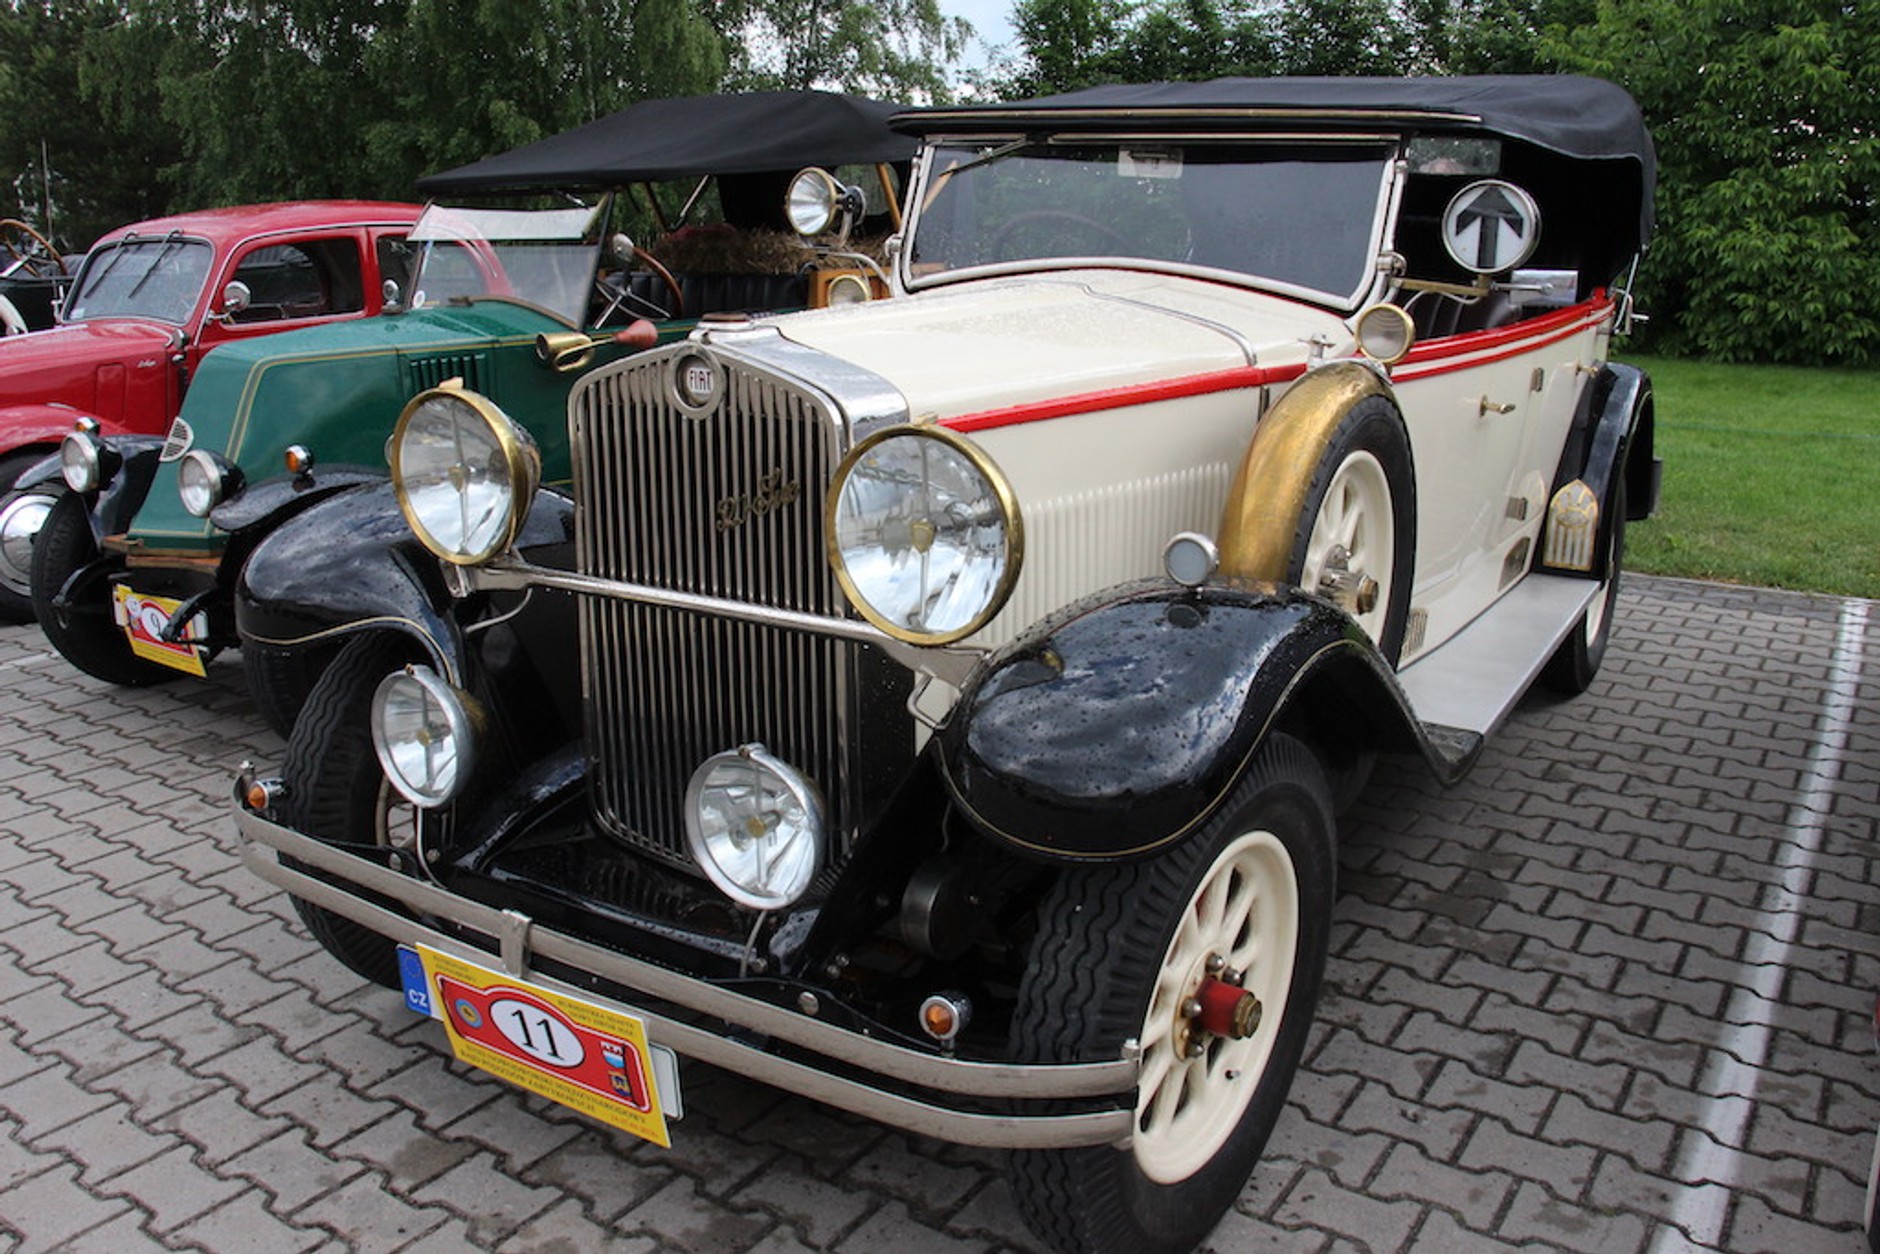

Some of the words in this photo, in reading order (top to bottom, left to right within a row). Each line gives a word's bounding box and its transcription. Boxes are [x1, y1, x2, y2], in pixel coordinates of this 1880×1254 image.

[690, 370, 711, 390] FIAT
[408, 988, 428, 1008] CZ
[511, 1009, 565, 1061] 11
